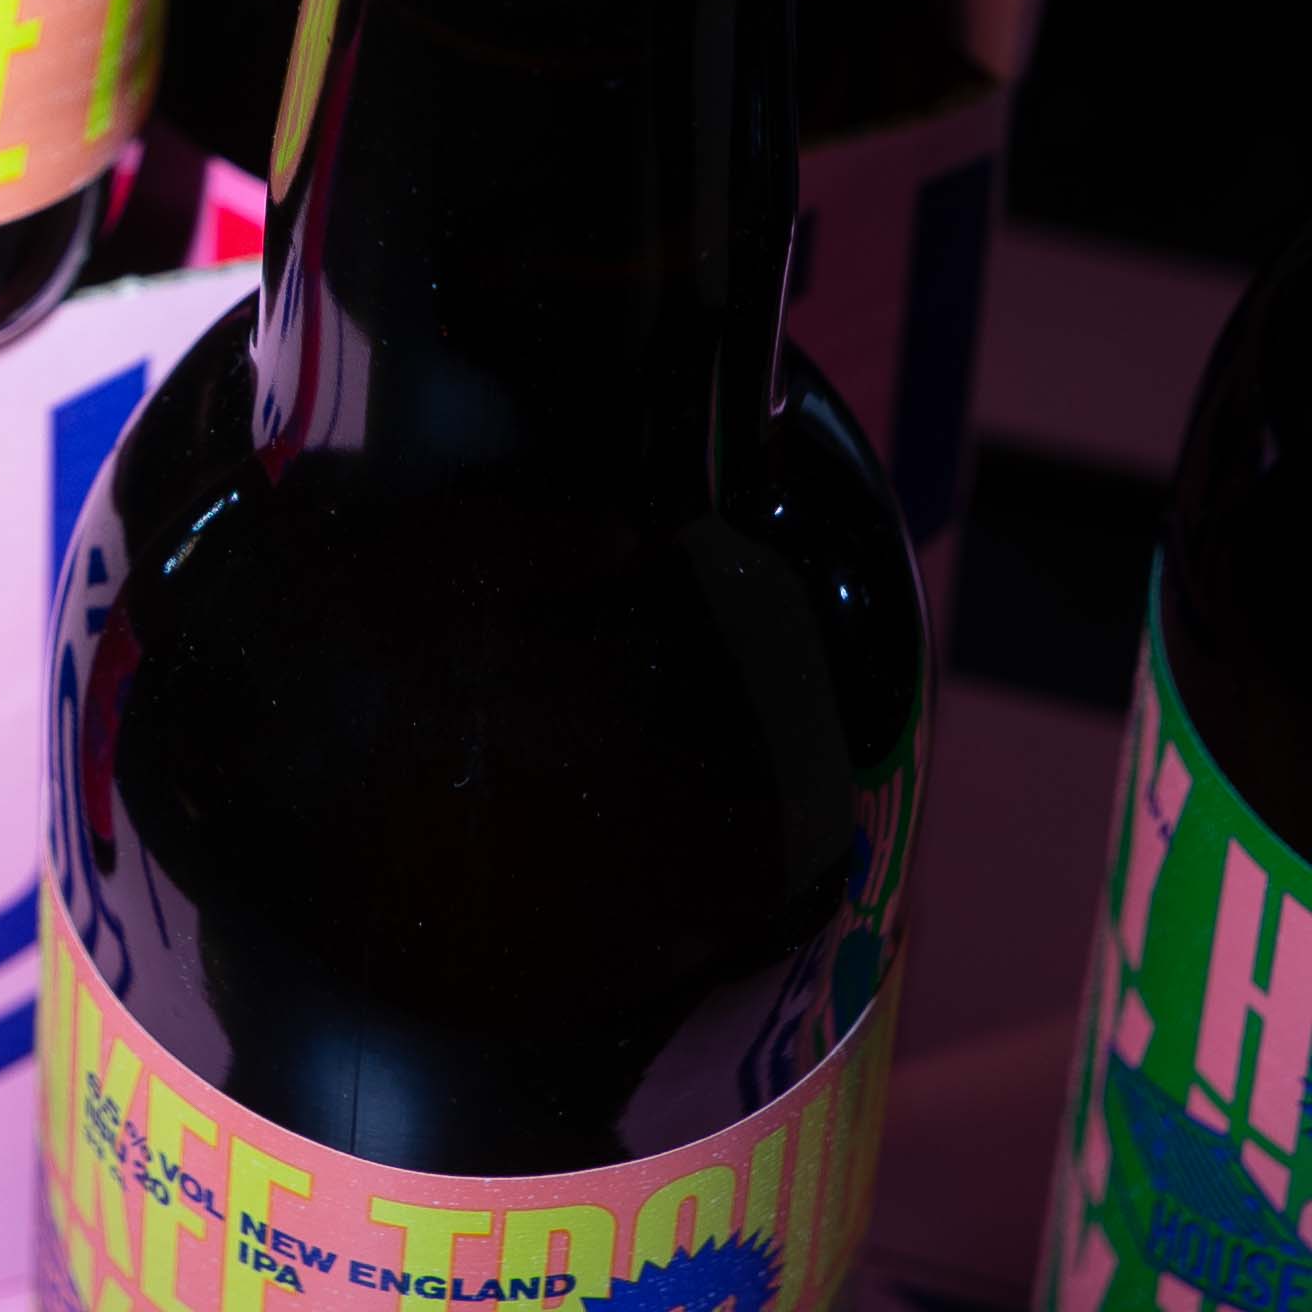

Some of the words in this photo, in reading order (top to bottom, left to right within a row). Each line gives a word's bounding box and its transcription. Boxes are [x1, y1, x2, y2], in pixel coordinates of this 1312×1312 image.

[157, 1150, 226, 1221] VOL
[239, 1210, 339, 1275] NEW
[347, 1259, 578, 1304] ENGLAND
[237, 1240, 307, 1295] IPA
